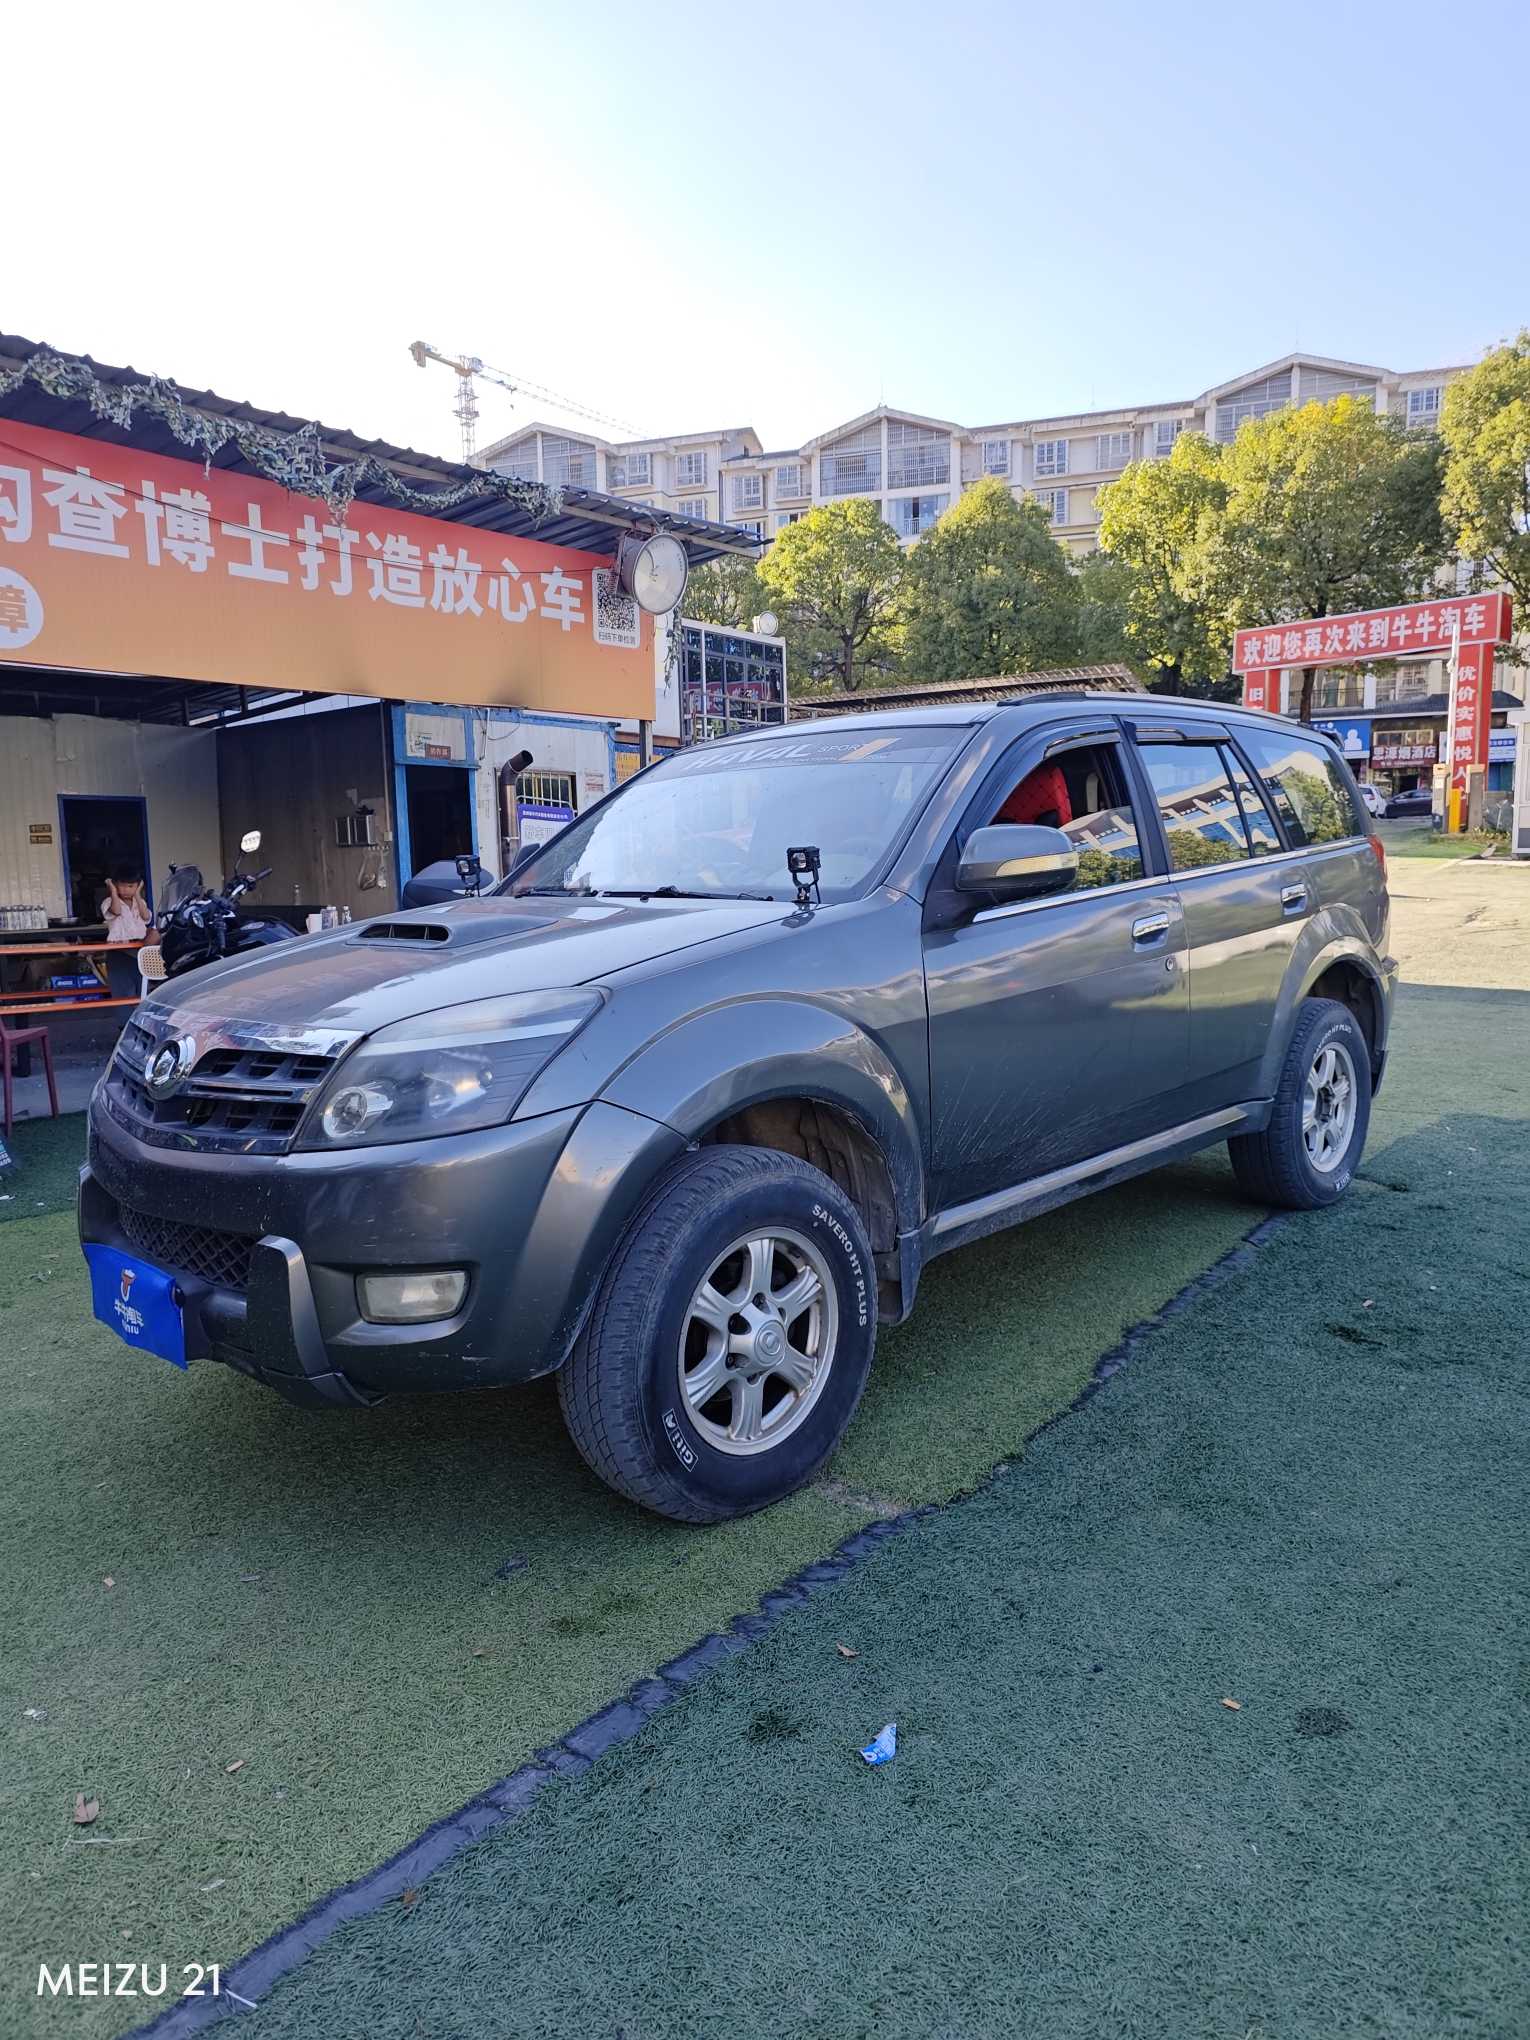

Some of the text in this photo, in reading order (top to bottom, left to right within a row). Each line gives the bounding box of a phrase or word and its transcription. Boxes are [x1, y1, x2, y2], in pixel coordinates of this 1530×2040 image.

[1243, 603, 1486, 665] 欢迎您再次来到牛牛淘车
[812, 1204, 868, 1327] SAVERO HT PLUS
